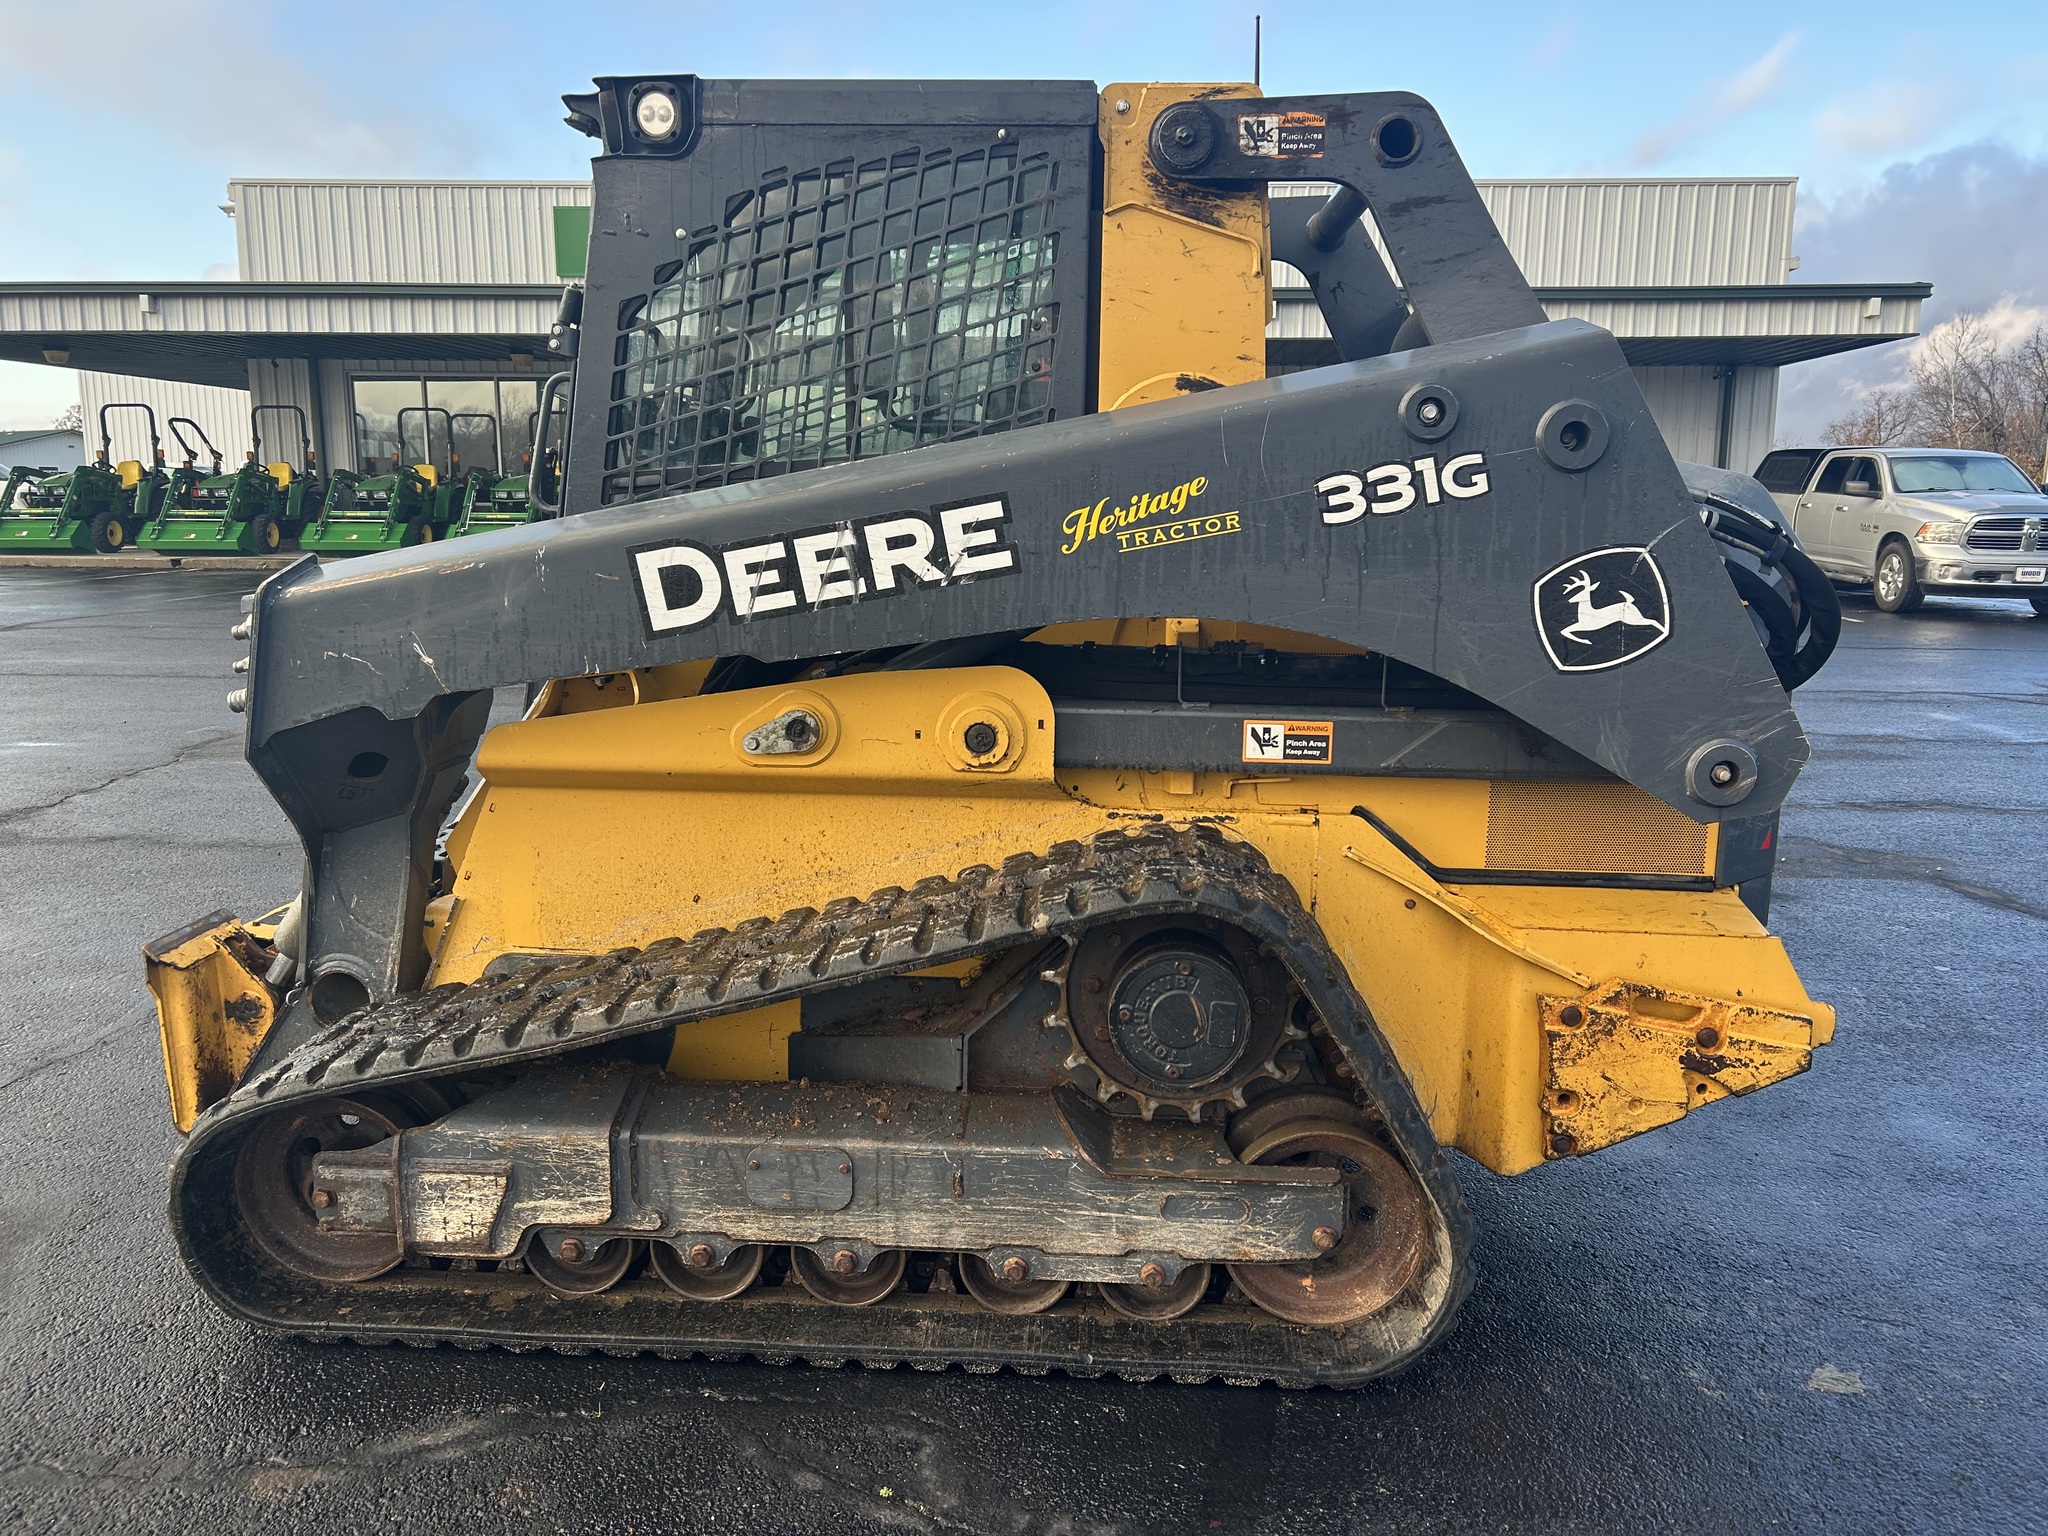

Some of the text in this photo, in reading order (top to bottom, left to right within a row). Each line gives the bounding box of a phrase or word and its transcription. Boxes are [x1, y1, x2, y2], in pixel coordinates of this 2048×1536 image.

[1281, 142, 1317, 150] Keep Away
[1061, 475, 1209, 554] Heritage
[1317, 453, 1490, 525] 331G
[1117, 512, 1242, 549] TRACTOR
[634, 500, 1014, 632] DEERE
[1286, 739, 1307, 747] Pinch
